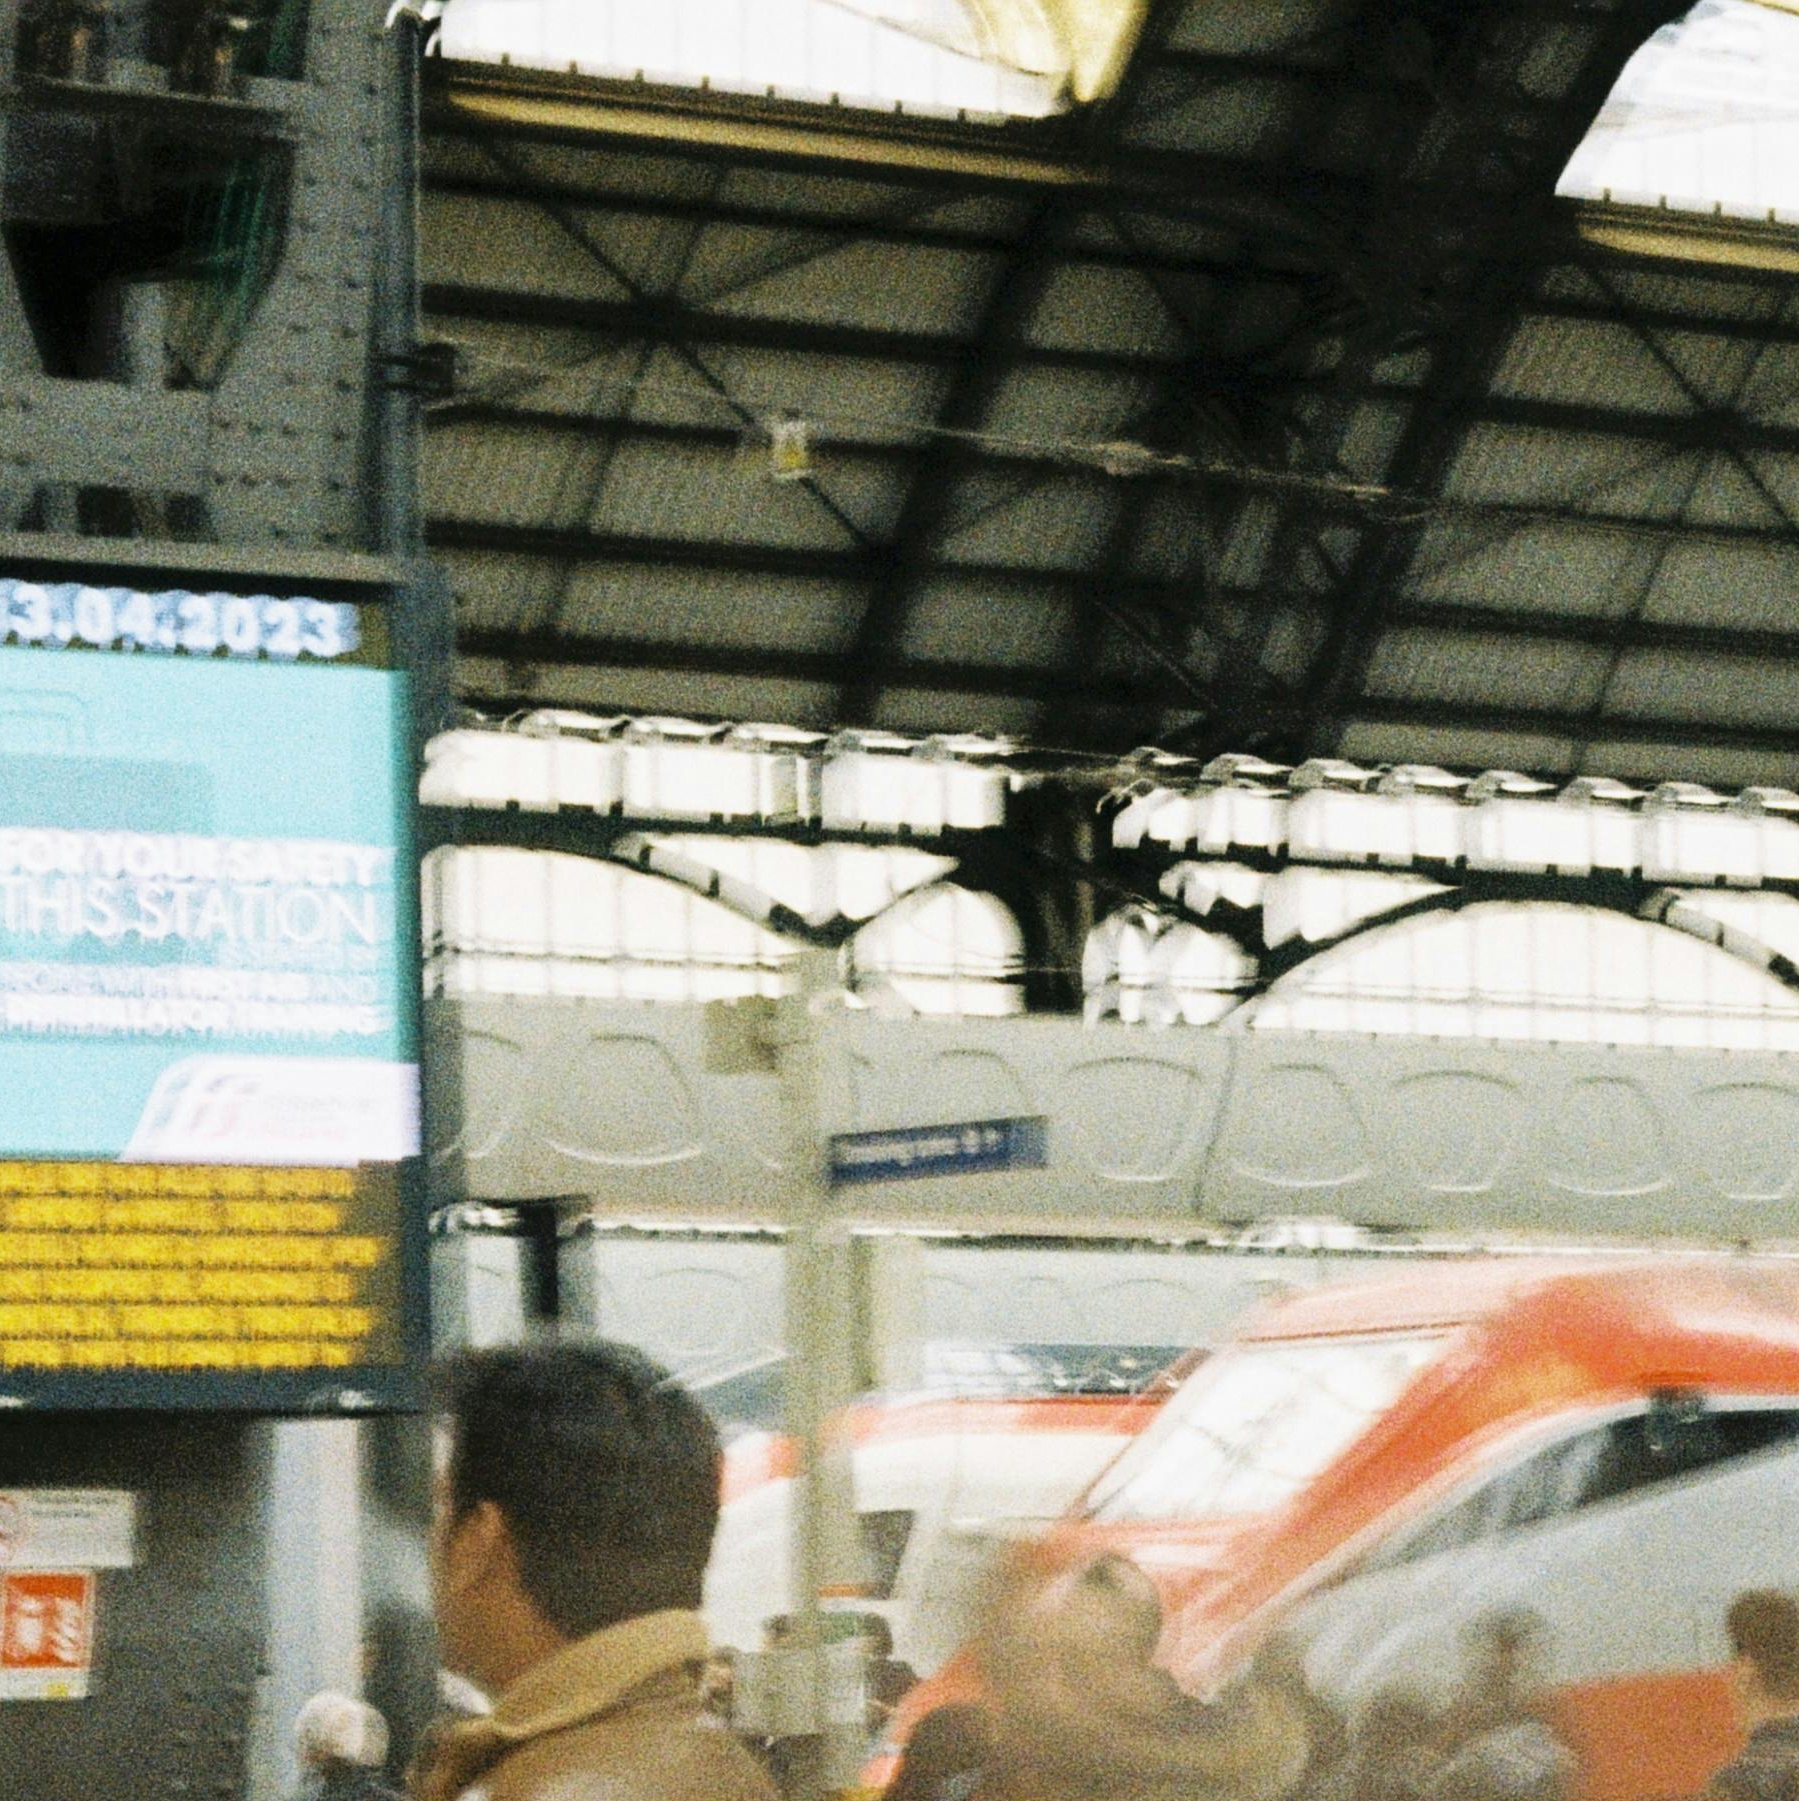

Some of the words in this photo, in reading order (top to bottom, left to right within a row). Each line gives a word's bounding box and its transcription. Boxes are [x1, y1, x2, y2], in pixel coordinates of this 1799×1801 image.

[94, 833, 218, 879] YOUR
[230, 838, 385, 887] SAFETY
[136, 880, 379, 944] STATION
